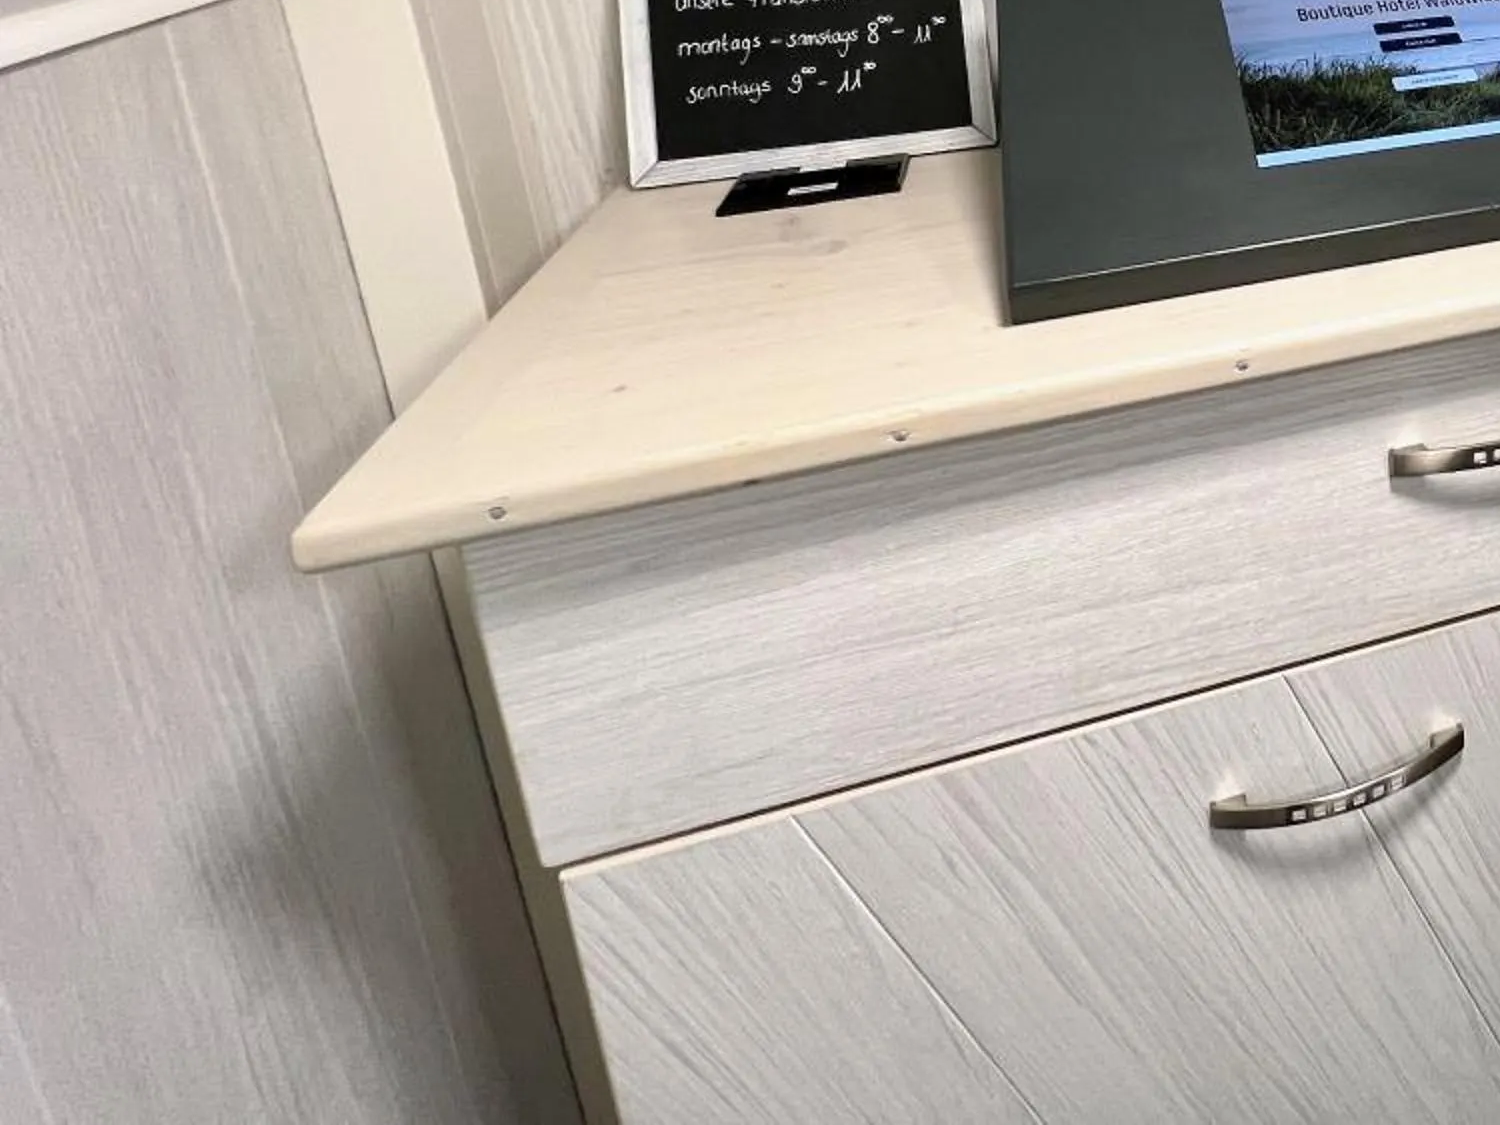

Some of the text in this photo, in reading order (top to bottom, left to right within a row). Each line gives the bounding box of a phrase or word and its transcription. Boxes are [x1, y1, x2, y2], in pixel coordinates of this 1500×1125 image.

[1296, 1, 1374, 22] Boutique
[677, 32, 762, 66] montags
[785, 27, 860, 58] samstags
[686, 79, 772, 104] sonntags
